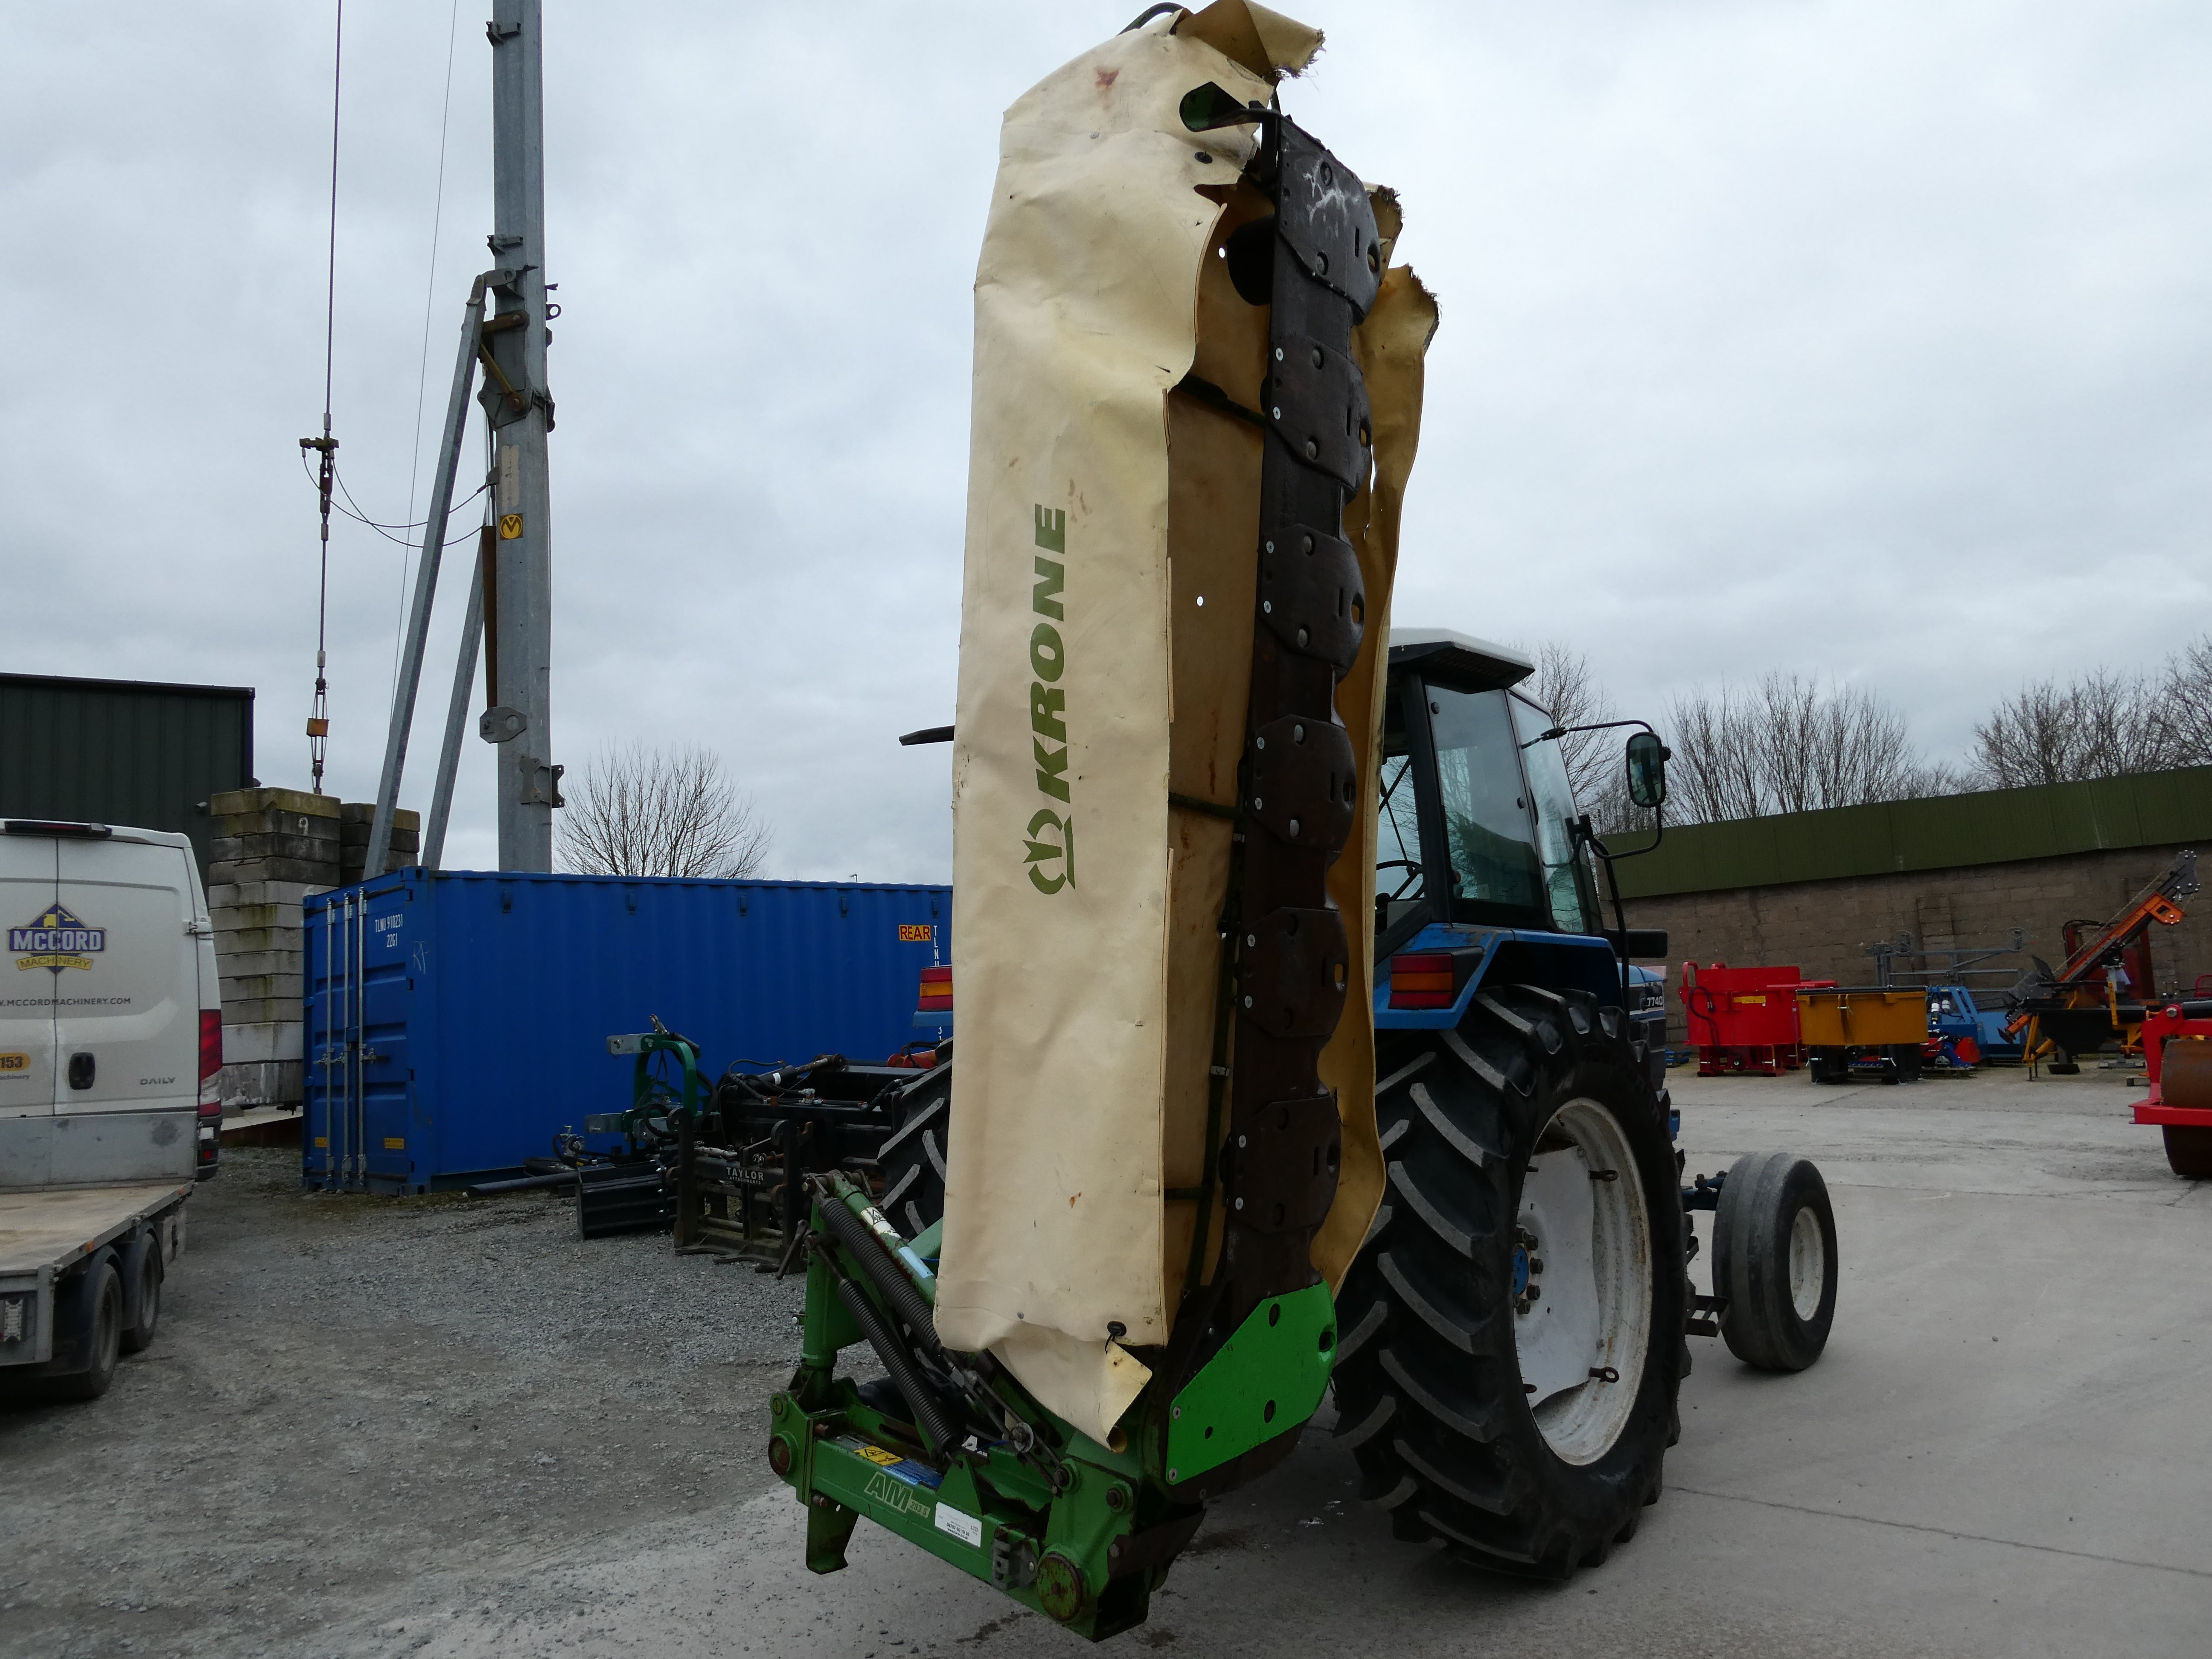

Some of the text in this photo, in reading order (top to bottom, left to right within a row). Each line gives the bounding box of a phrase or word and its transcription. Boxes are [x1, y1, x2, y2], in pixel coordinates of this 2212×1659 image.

[1030, 503, 1071, 804] KRONE
[900, 926, 931, 940] REAR
[20, 957, 91, 967] MACHINERY
[1647, 995, 1663, 1007] 7740
[140, 1077, 176, 1085] DAILY
[726, 1167, 764, 1181] TAYLOR
[864, 1471, 914, 1513] AM
